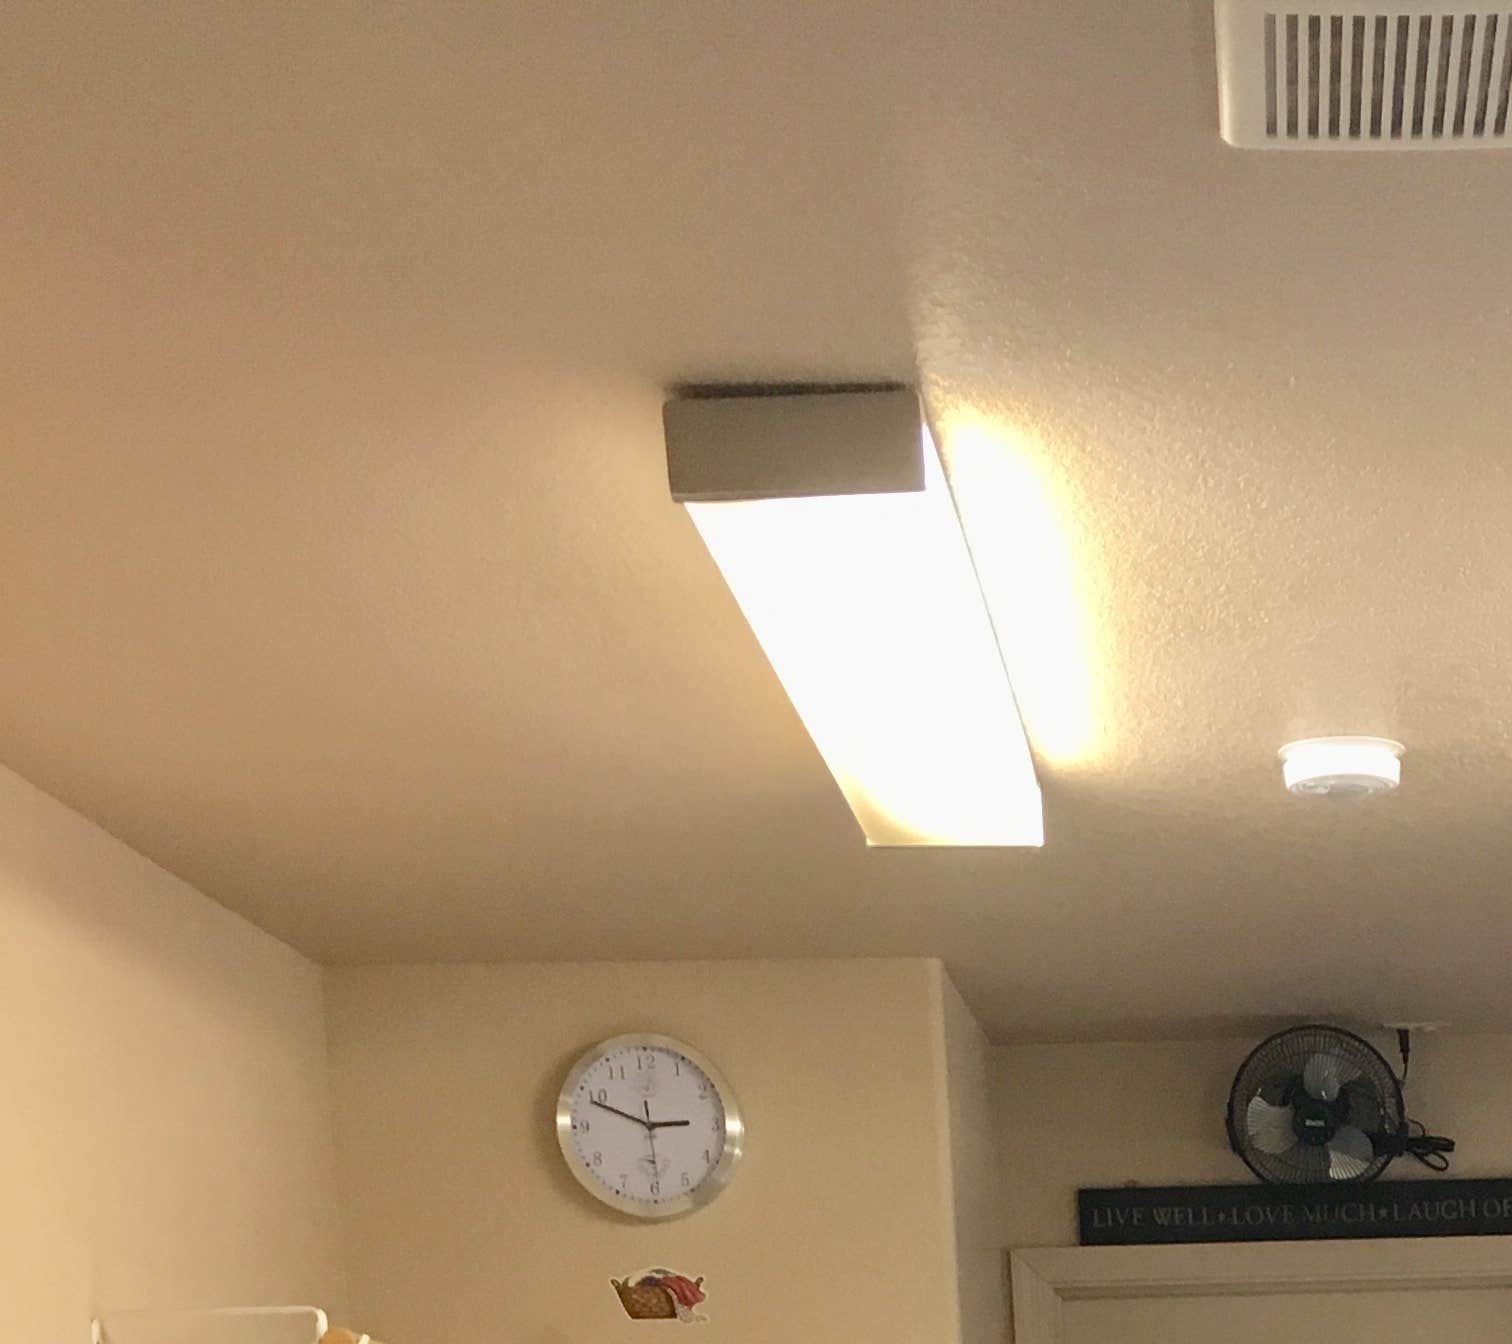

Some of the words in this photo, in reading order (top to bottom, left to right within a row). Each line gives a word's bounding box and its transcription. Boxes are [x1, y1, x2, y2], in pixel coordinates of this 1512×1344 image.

[636, 1055, 655, 1070] 12
[609, 1065, 626, 1080] 11
[1092, 1207, 1143, 1229] LIVE
[1152, 1205, 1216, 1227] WELL
[1229, 1204, 1296, 1225] LOVE
[1303, 1202, 1377, 1224] MUCH
[1392, 1199, 1474, 1223] LAUGH
